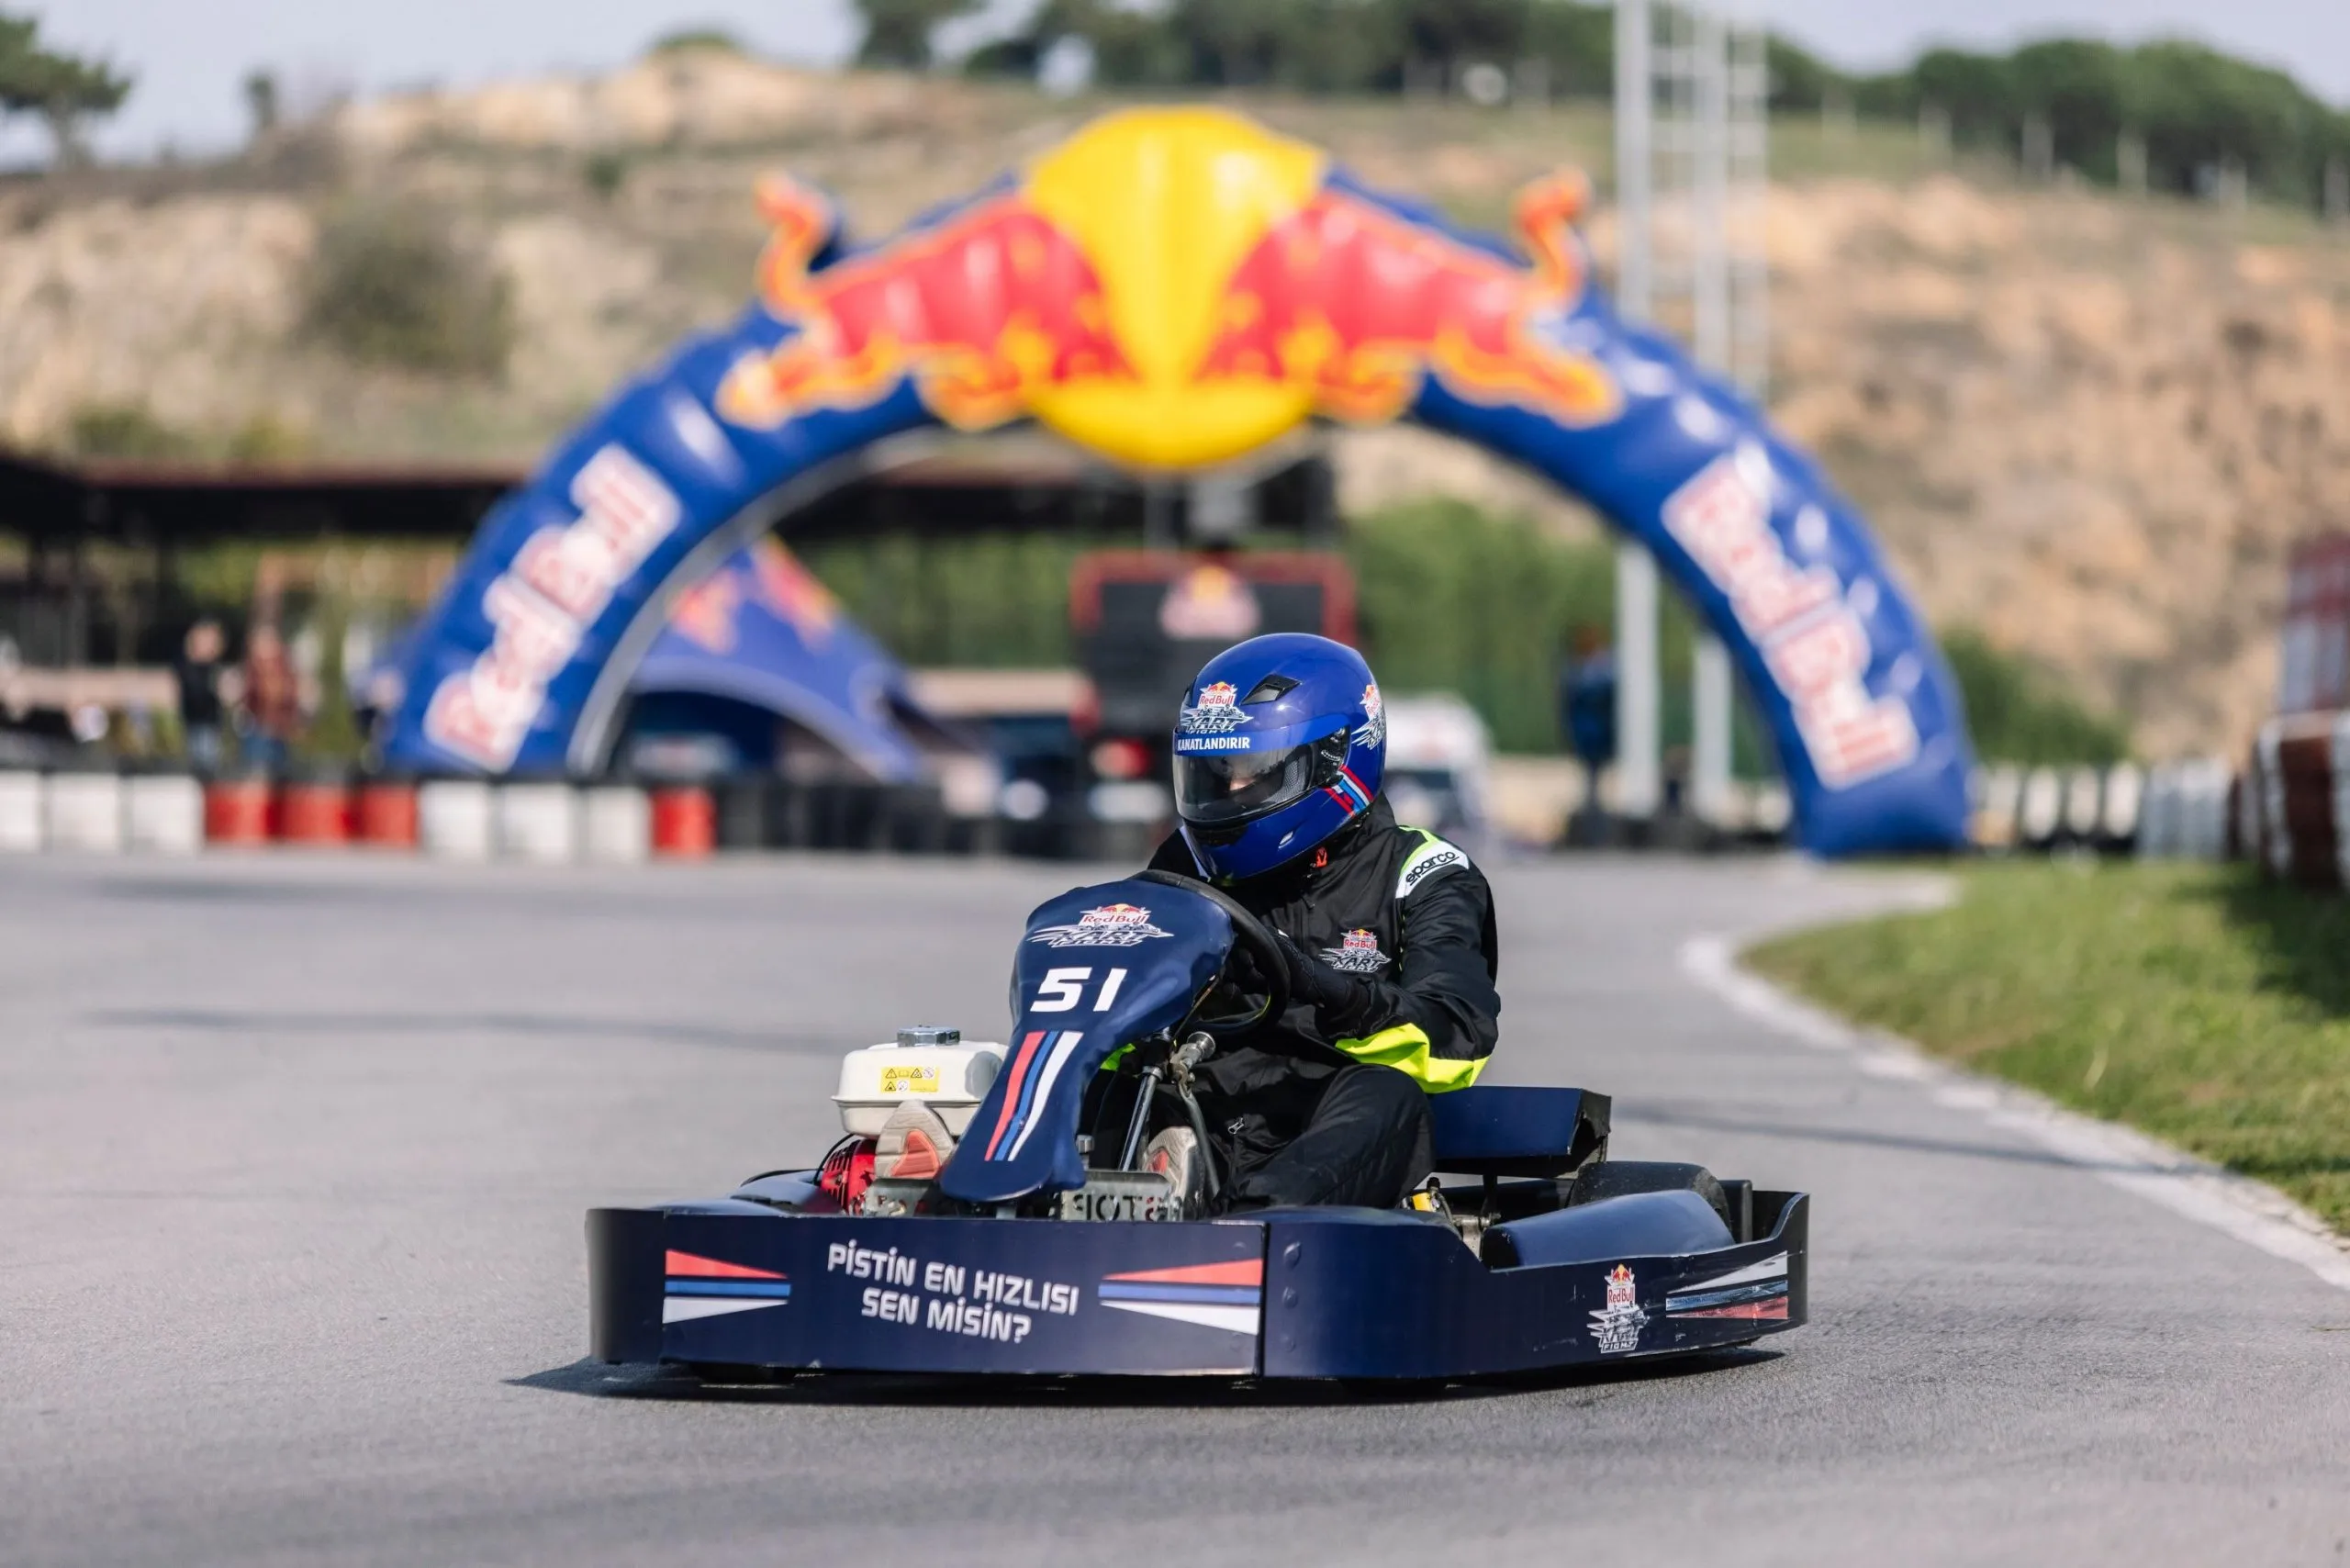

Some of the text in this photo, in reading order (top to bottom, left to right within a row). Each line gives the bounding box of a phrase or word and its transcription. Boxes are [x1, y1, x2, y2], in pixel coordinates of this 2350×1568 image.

[1200, 695, 1234, 705] Red Bull
[1177, 737, 1250, 751] KANATLANDIRIR
[1405, 851, 1457, 884] sparco
[1115, 915, 1147, 924] Bull
[1344, 939, 1376, 949] Red Bull
[1030, 967, 1127, 1012] 51
[827, 1239, 1079, 1316] PİSTİN EN HIZLISI
[1608, 1287, 1634, 1303] Red Bull
[861, 1287, 1032, 1343] SEN MİSİN?
